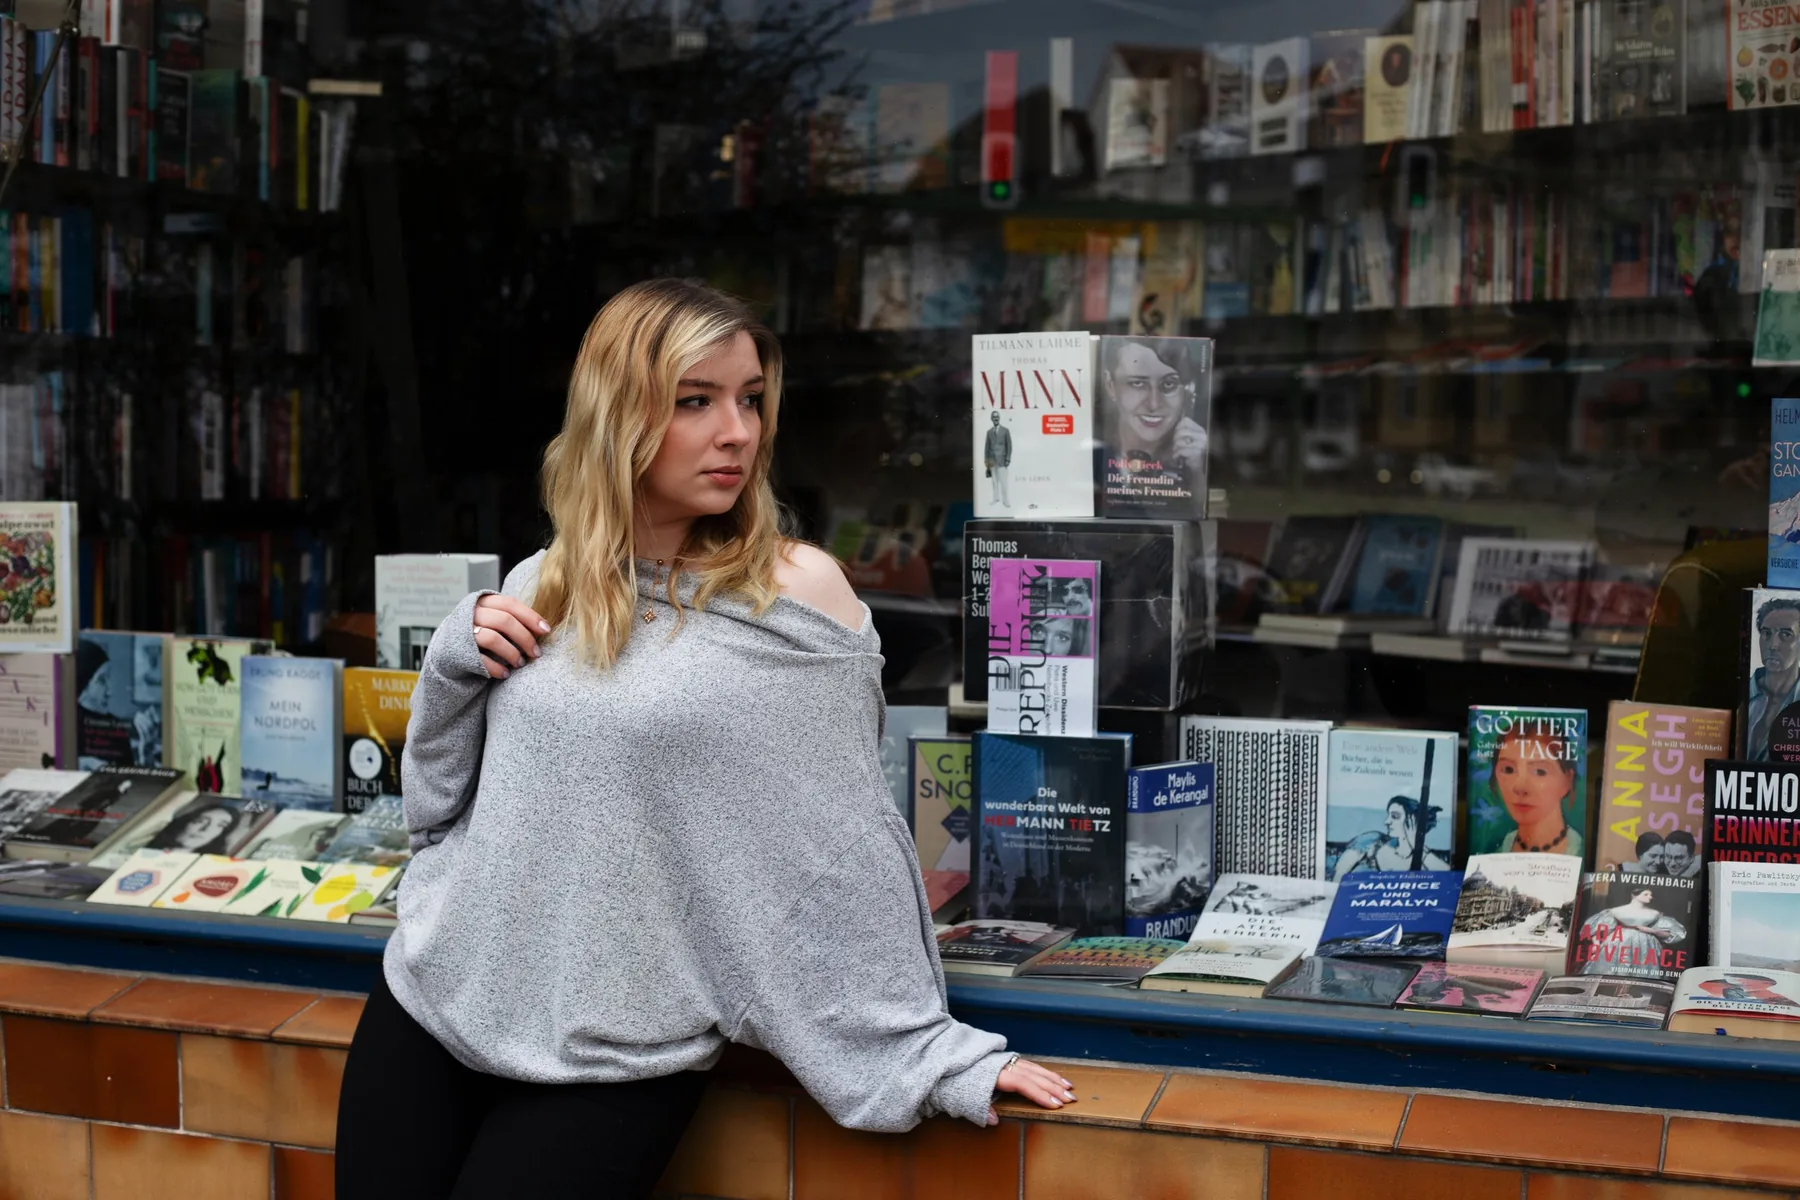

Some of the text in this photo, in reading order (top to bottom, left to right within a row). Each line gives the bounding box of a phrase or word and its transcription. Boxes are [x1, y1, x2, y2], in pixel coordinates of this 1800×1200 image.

[1737, 5, 1800, 31] ESSEN
[979, 337, 1082, 351] TILMANN LAHME
[1012, 357, 1048, 365] THOMAS
[980, 369, 1082, 410] MANN
[1108, 459, 1133, 472] Polly
[1107, 473, 1174, 485] Die Freundin
[1107, 486, 1192, 498] meines Freundes
[972, 537, 1018, 553] Thomas
[1771, 557, 1799, 569] VERSUCHE
[988, 622, 1012, 680] DIE
[1018, 564, 1048, 736] REPUBLIK
[269, 701, 302, 713] MEIN
[254, 716, 317, 731] NORDPOL
[1476, 711, 1579, 737] GÖTTER
[1187, 725, 1319, 747] designreportagen
[1396, 744, 1417, 754] Welt
[1514, 739, 1578, 761] TAGE
[1680, 741, 1723, 752] Wirklichkeit
[1773, 743, 1800, 752] CHRIS
[1371, 756, 1381, 764] die
[1354, 766, 1386, 776] Zukunft
[1610, 710, 1649, 844] ANNA
[1648, 714, 1687, 831] SEGH
[347, 777, 383, 794] BUCH
[1168, 772, 1196, 791] Maylis
[920, 779, 971, 800] SNO
[1037, 787, 1057, 798] Die
[1153, 785, 1209, 806] de Kerangal
[1714, 769, 1799, 814] MEMO
[985, 801, 1111, 815] wunderbare Welt von
[984, 815, 1065, 830] HERMANN
[1069, 818, 1111, 832] TIETZ
[1527, 870, 1571, 879] gestern
[1589, 872, 1695, 889] VERA WEIDENBACH
[1731, 870, 1800, 882] Eric Pawlitzky
[1358, 882, 1441, 890] MAURICE
[1350, 899, 1439, 908] MARALYN
[1248, 917, 1276, 925] DIE
[1213, 929, 1301, 940] LEHRERIN
[1580, 924, 1624, 943] ADA
[1576, 944, 1688, 970] LOVELACE
[1611, 966, 1649, 975] VISIONÄRIN
